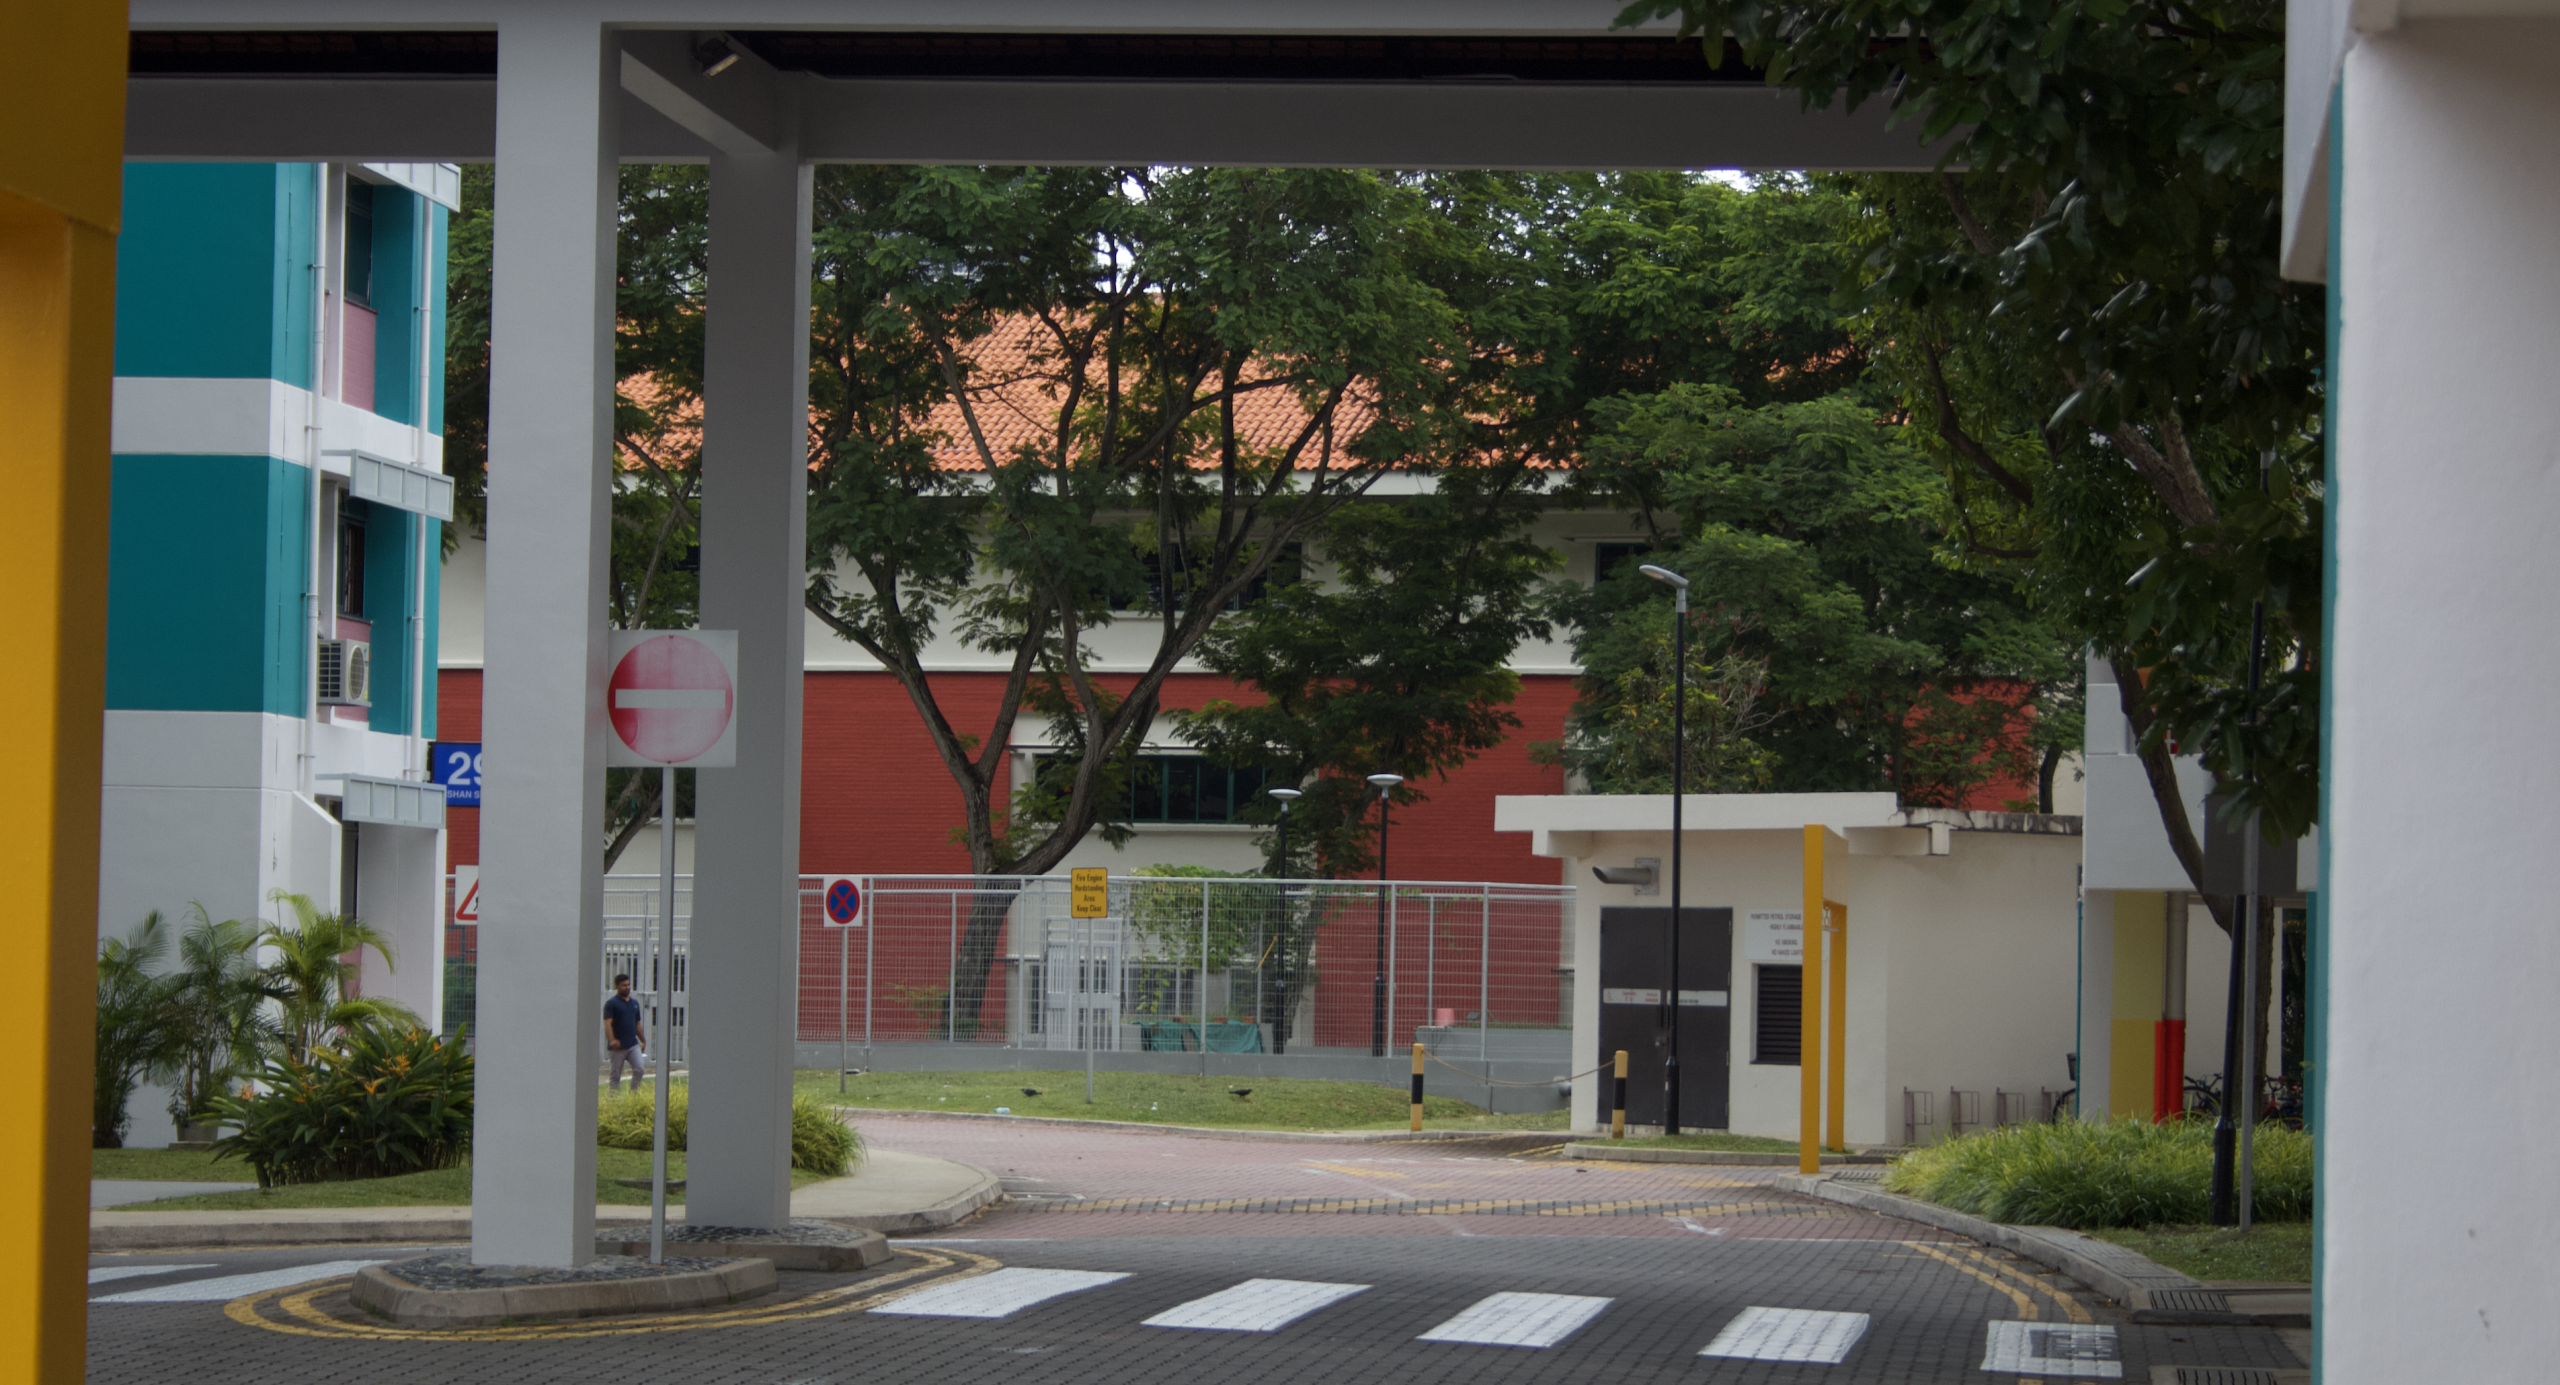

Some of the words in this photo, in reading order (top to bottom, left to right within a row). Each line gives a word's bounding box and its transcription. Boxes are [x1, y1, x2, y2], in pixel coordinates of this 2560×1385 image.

[474, 790, 480, 799] S
[1087, 874, 1102, 883] Engine
[1074, 884, 1104, 893] Hardstanding
[1084, 894, 1095, 902] Area
[1076, 904, 1088, 913] Keep
[1089, 904, 1102, 912] Clear
